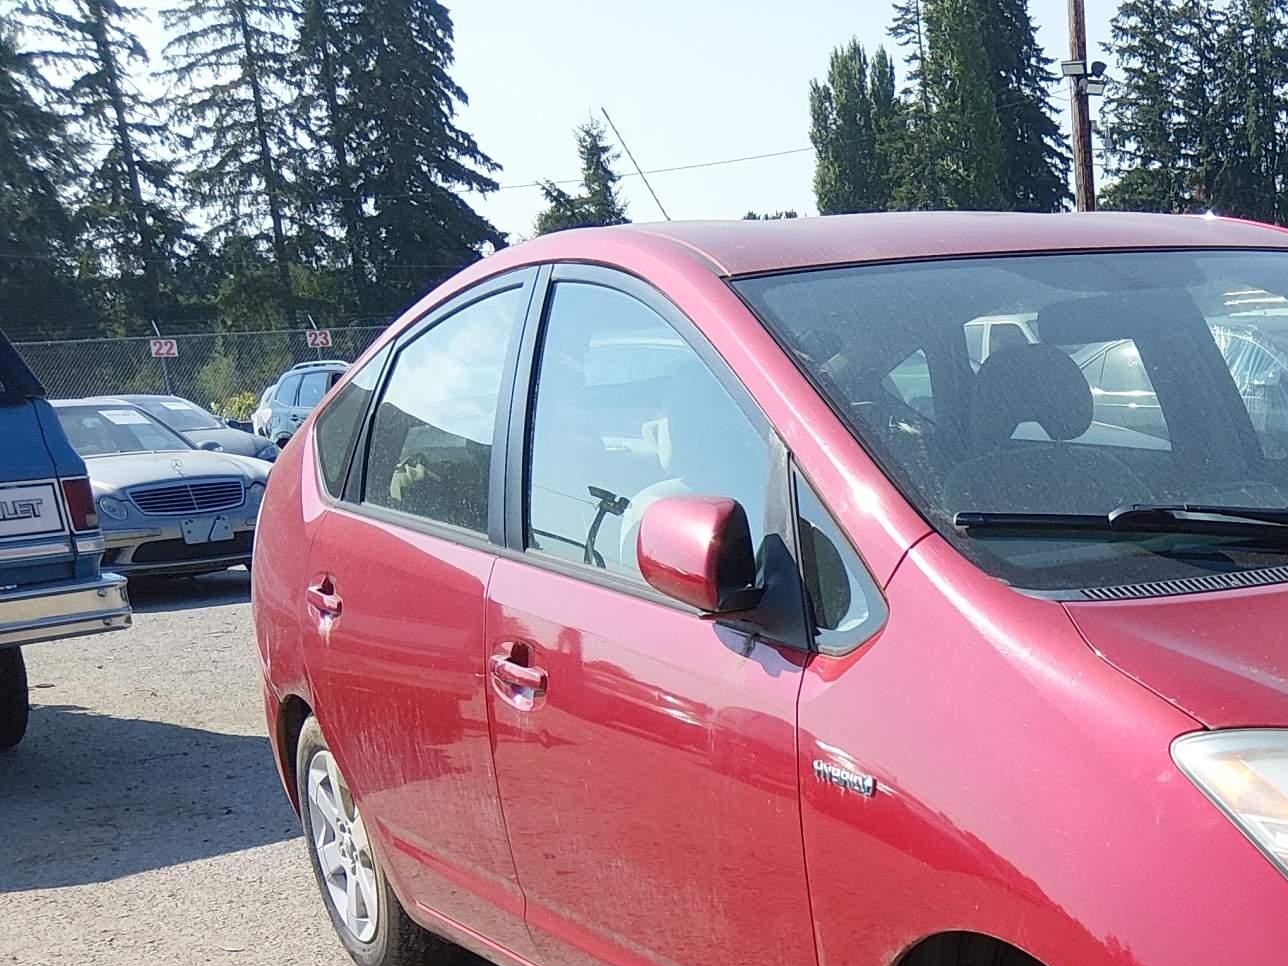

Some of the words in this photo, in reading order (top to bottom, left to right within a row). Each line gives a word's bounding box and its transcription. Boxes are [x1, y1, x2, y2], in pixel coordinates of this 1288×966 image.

[308, 331, 330, 347] 23
[152, 340, 176, 357] 22
[0, 498, 43, 521] LET
